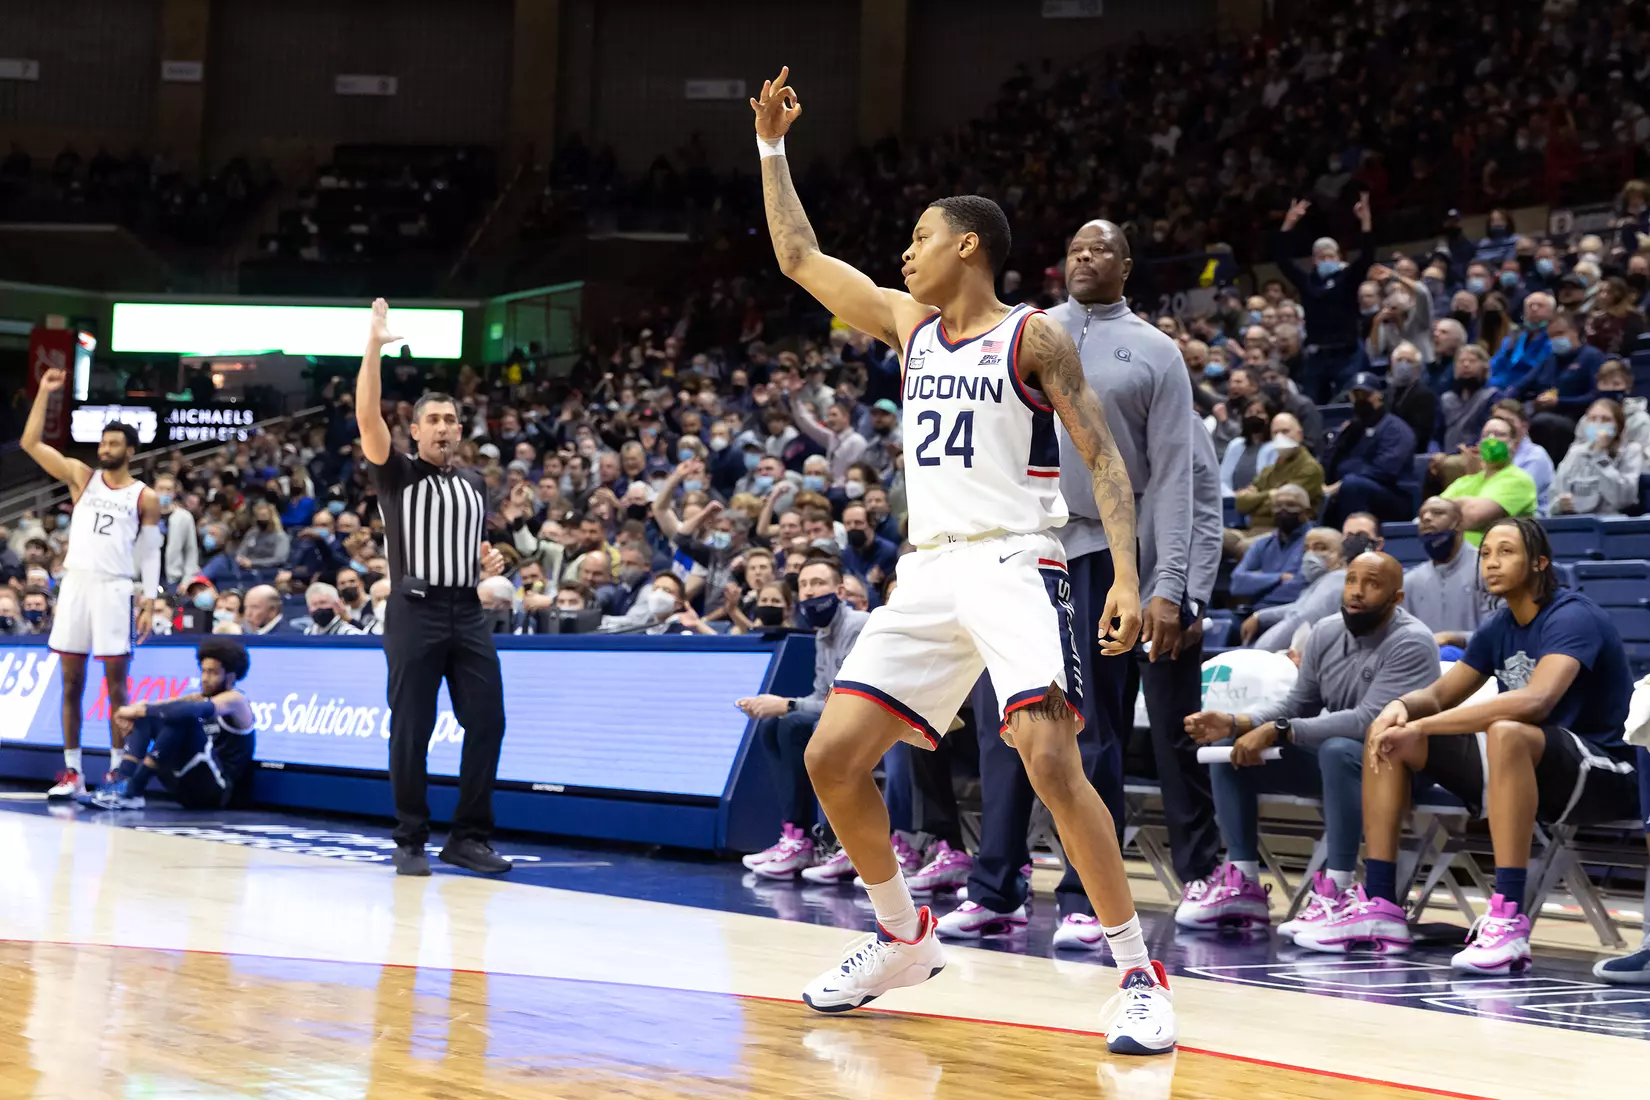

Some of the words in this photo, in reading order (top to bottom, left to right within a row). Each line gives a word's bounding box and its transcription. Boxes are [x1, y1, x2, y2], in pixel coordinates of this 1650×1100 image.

[907, 374, 1004, 404] UCONN
[916, 410, 974, 469] 24
[93, 512, 114, 536] 12
[0, 649, 50, 698] BS
[274, 692, 380, 738] Solutions
